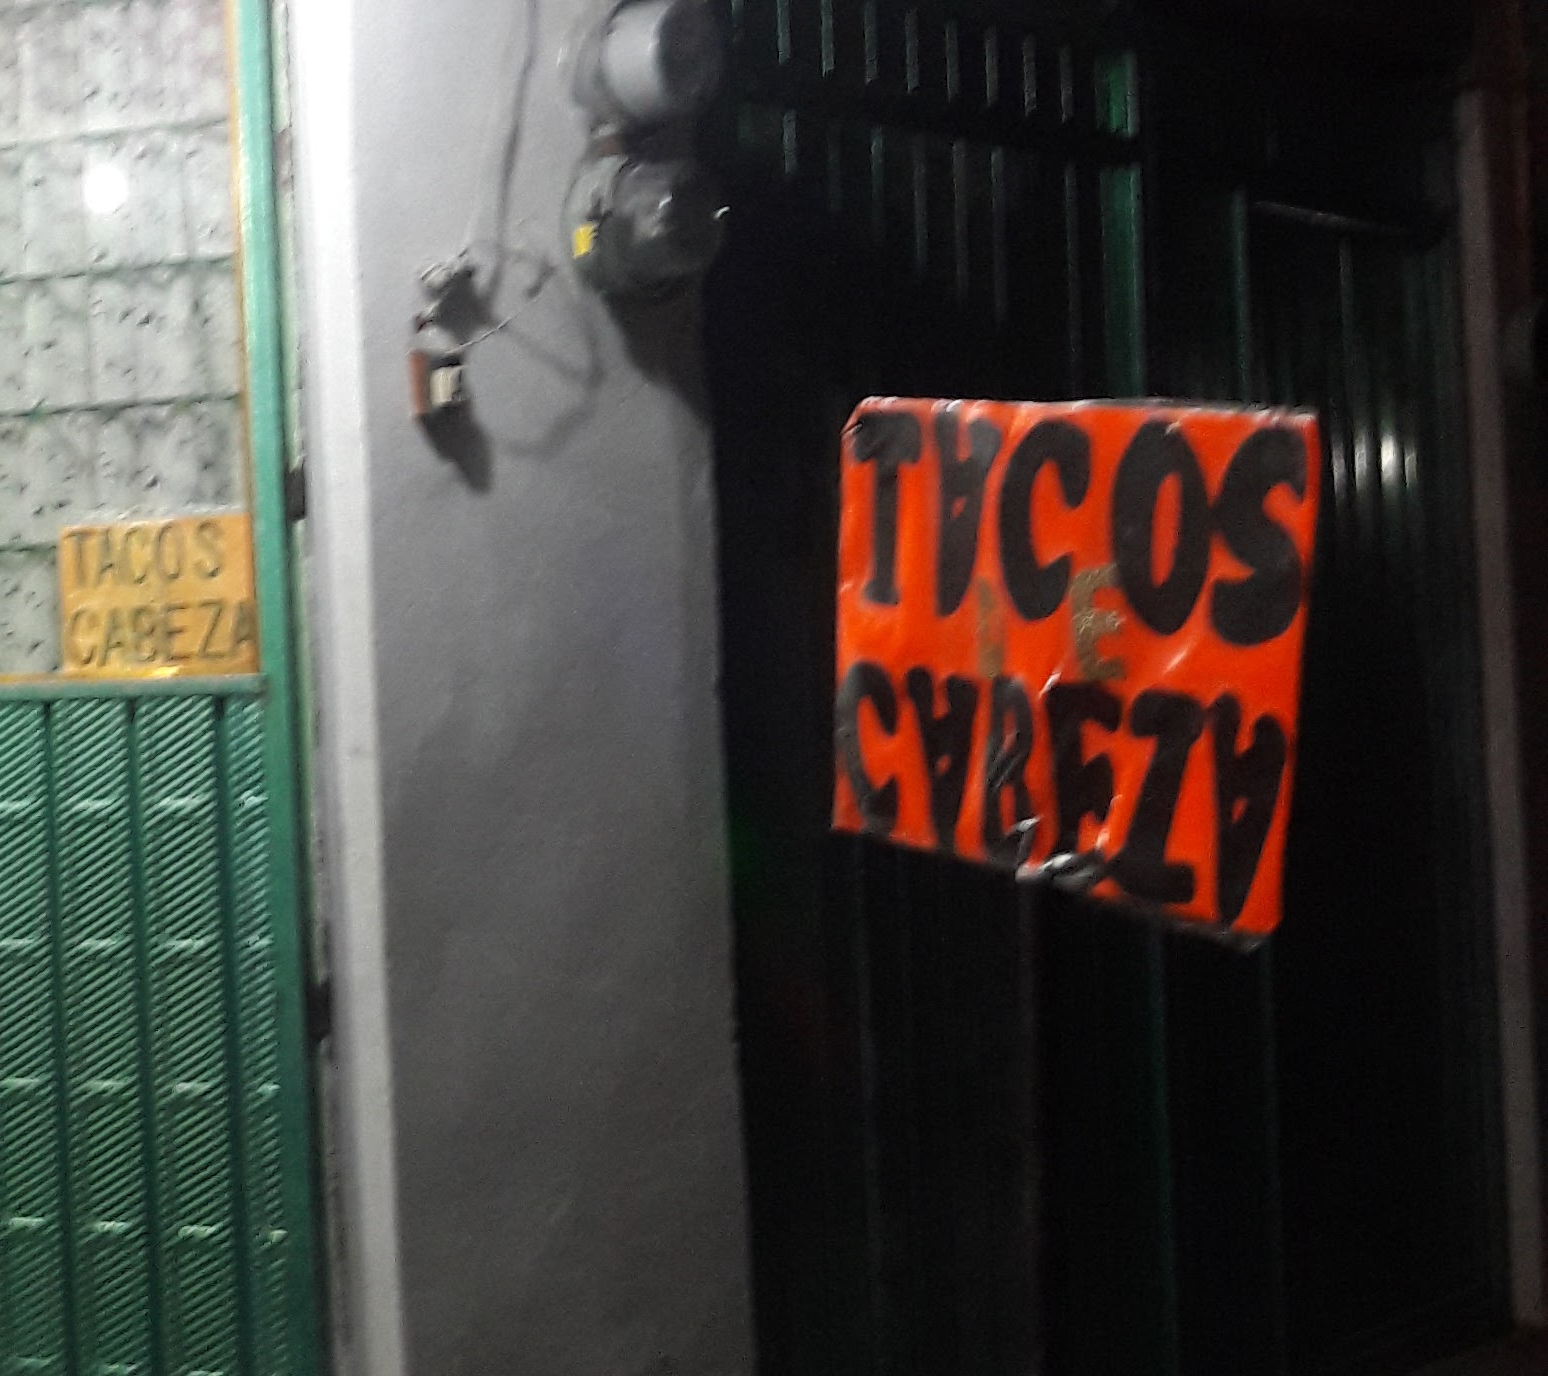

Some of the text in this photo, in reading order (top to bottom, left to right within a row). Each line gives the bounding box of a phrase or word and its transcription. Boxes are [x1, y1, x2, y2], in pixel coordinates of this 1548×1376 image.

[64, 520, 225, 588] TACOS
[846, 411, 1308, 647] TACOS
[67, 599, 258, 668] CABEZA
[835, 660, 1288, 926] CABEZA
